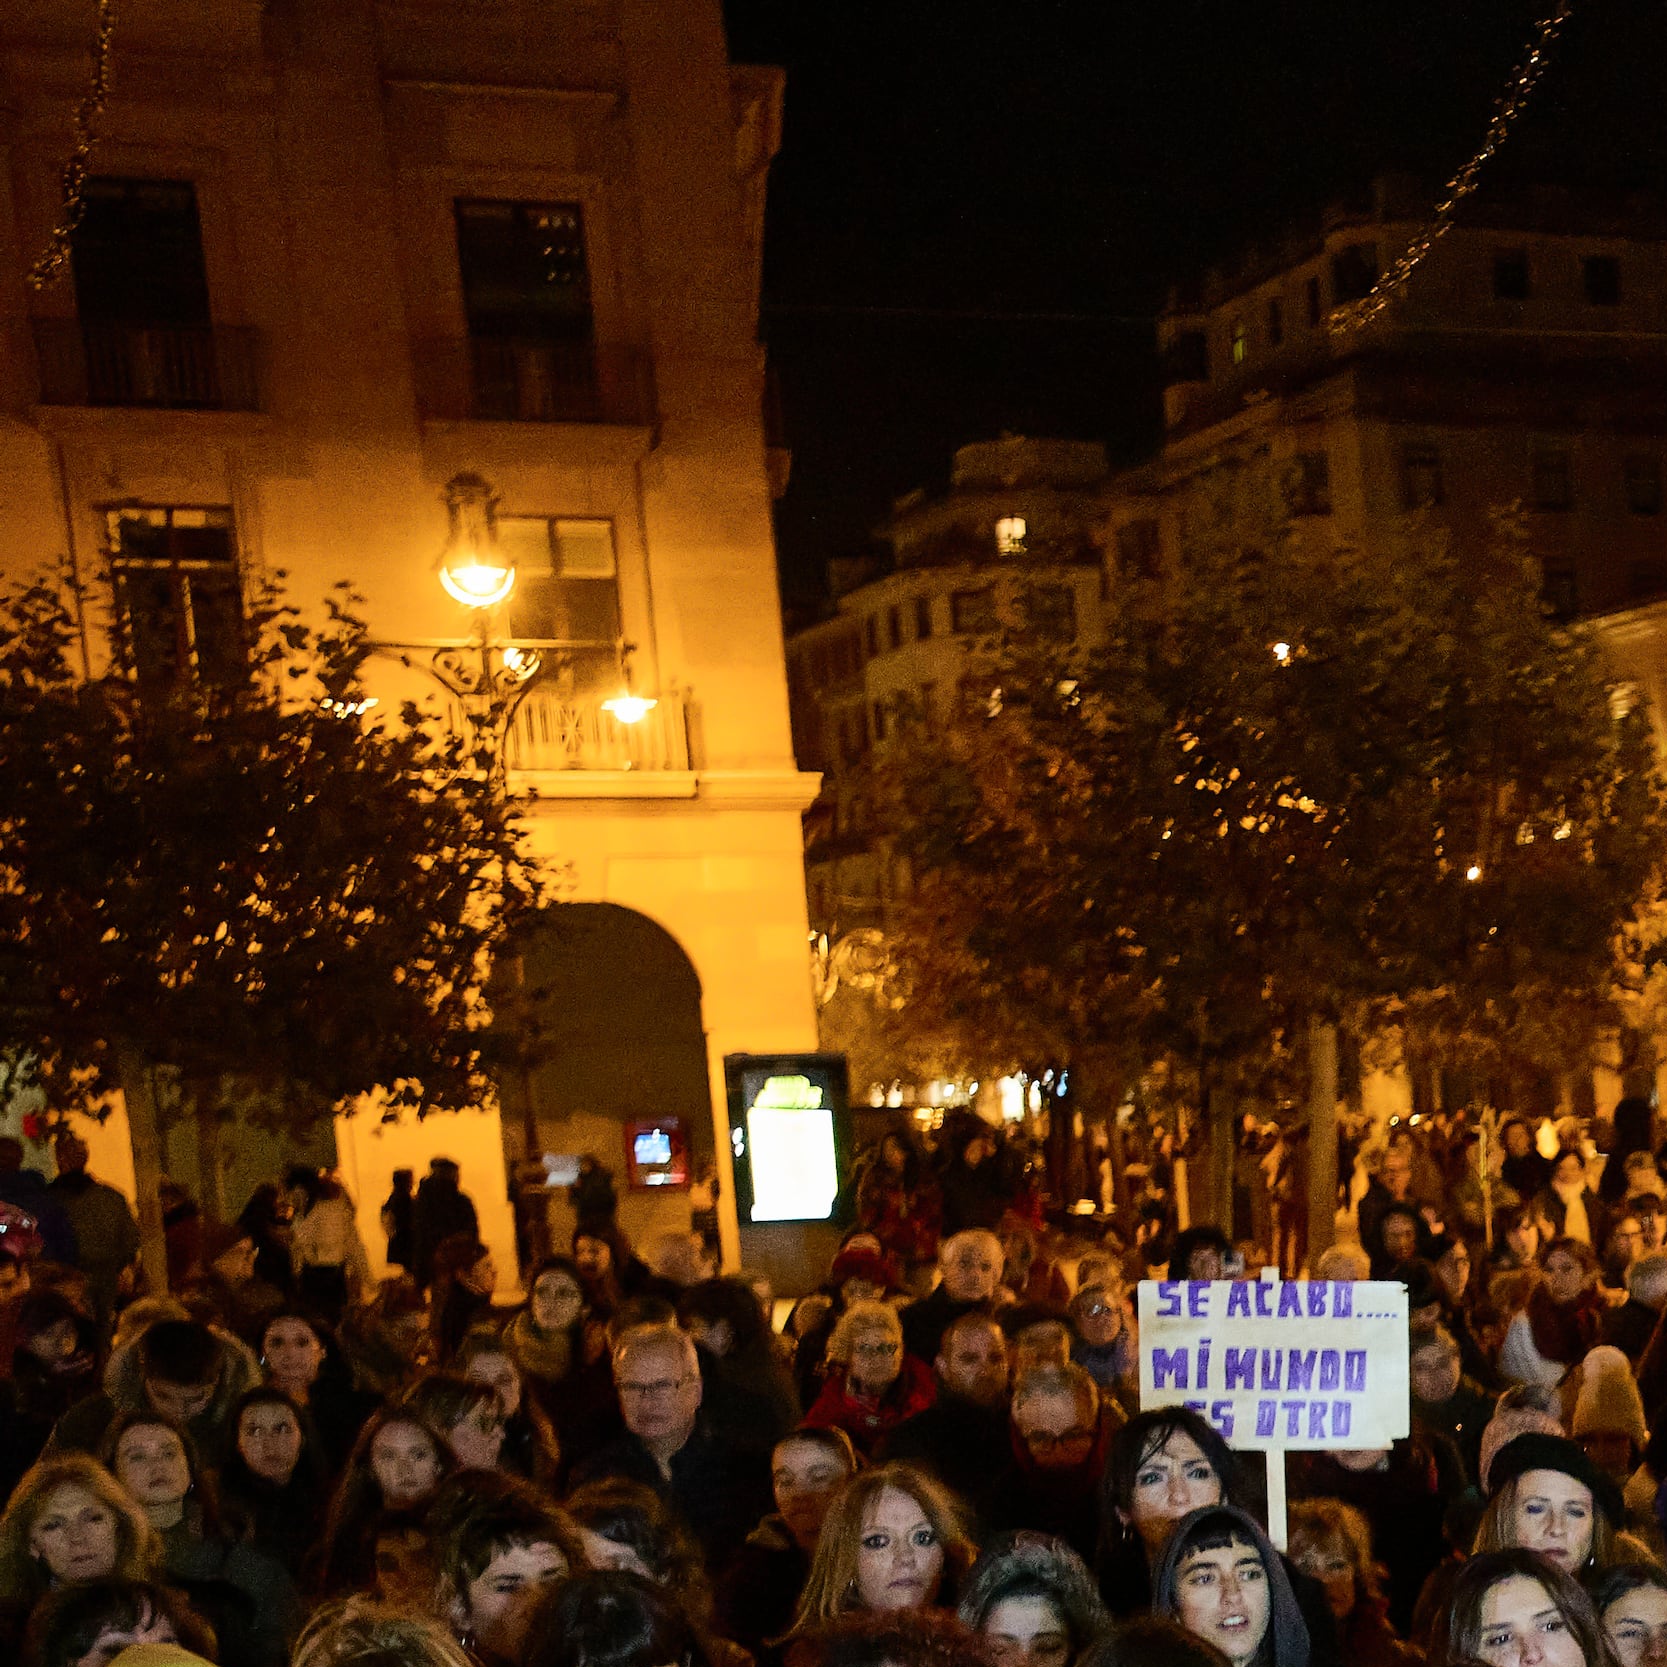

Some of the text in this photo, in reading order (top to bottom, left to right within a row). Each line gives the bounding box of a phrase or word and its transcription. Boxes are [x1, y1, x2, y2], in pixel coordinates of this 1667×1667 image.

[1156, 1281, 1212, 1318] SE
[1224, 1347, 1367, 1392] MUNDO
[1255, 1400, 1352, 1439] OTRO
